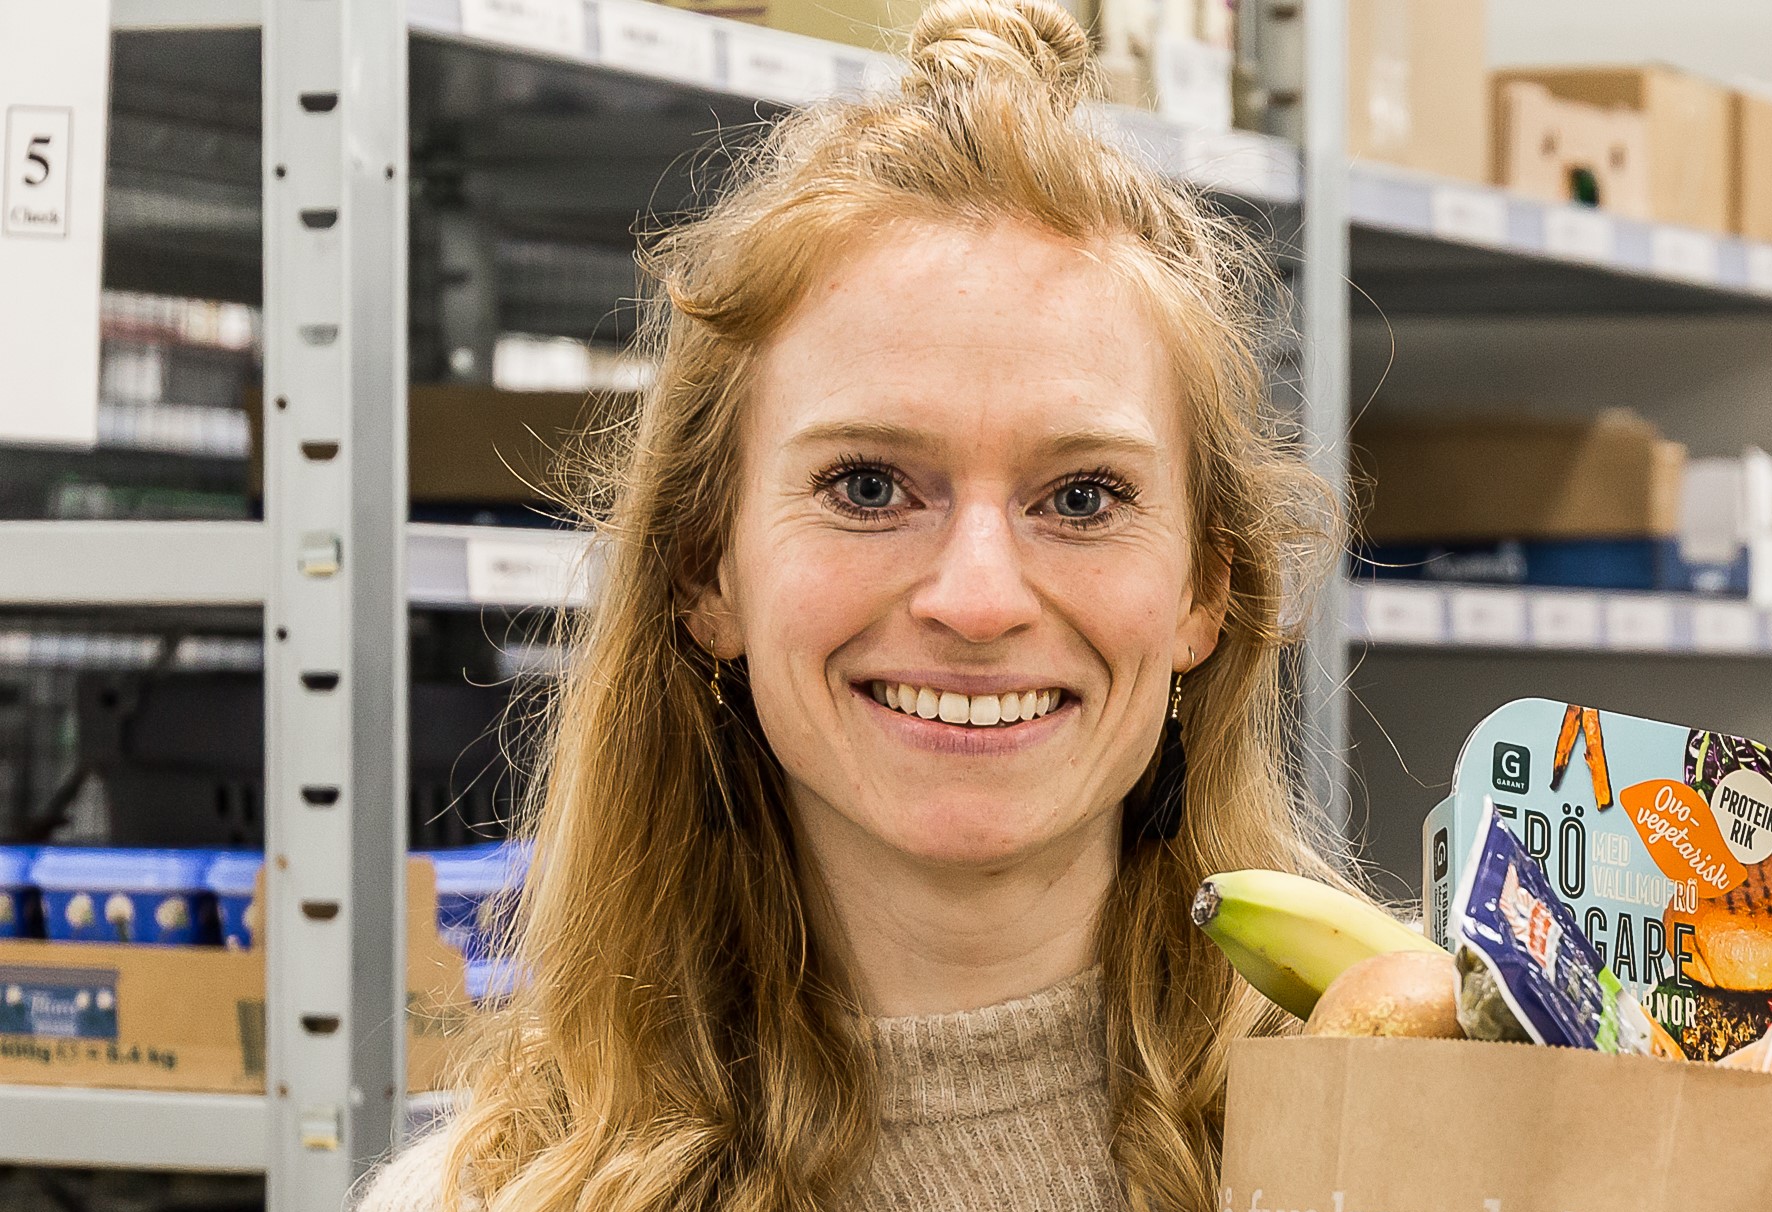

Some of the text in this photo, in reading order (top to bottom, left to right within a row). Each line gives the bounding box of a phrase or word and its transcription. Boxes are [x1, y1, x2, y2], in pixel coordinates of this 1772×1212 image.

[24, 134, 52, 188] 5
[1496, 778, 1526, 790] GARANT
[1501, 751, 1521, 778] G
[1654, 785, 1699, 827] Ovo-
[1591, 830, 1631, 867] MED
[1636, 807, 1730, 891] vegetarisk
[1729, 818, 1757, 850] RIK
[1592, 865, 1699, 915] VALLMOFRÖ
